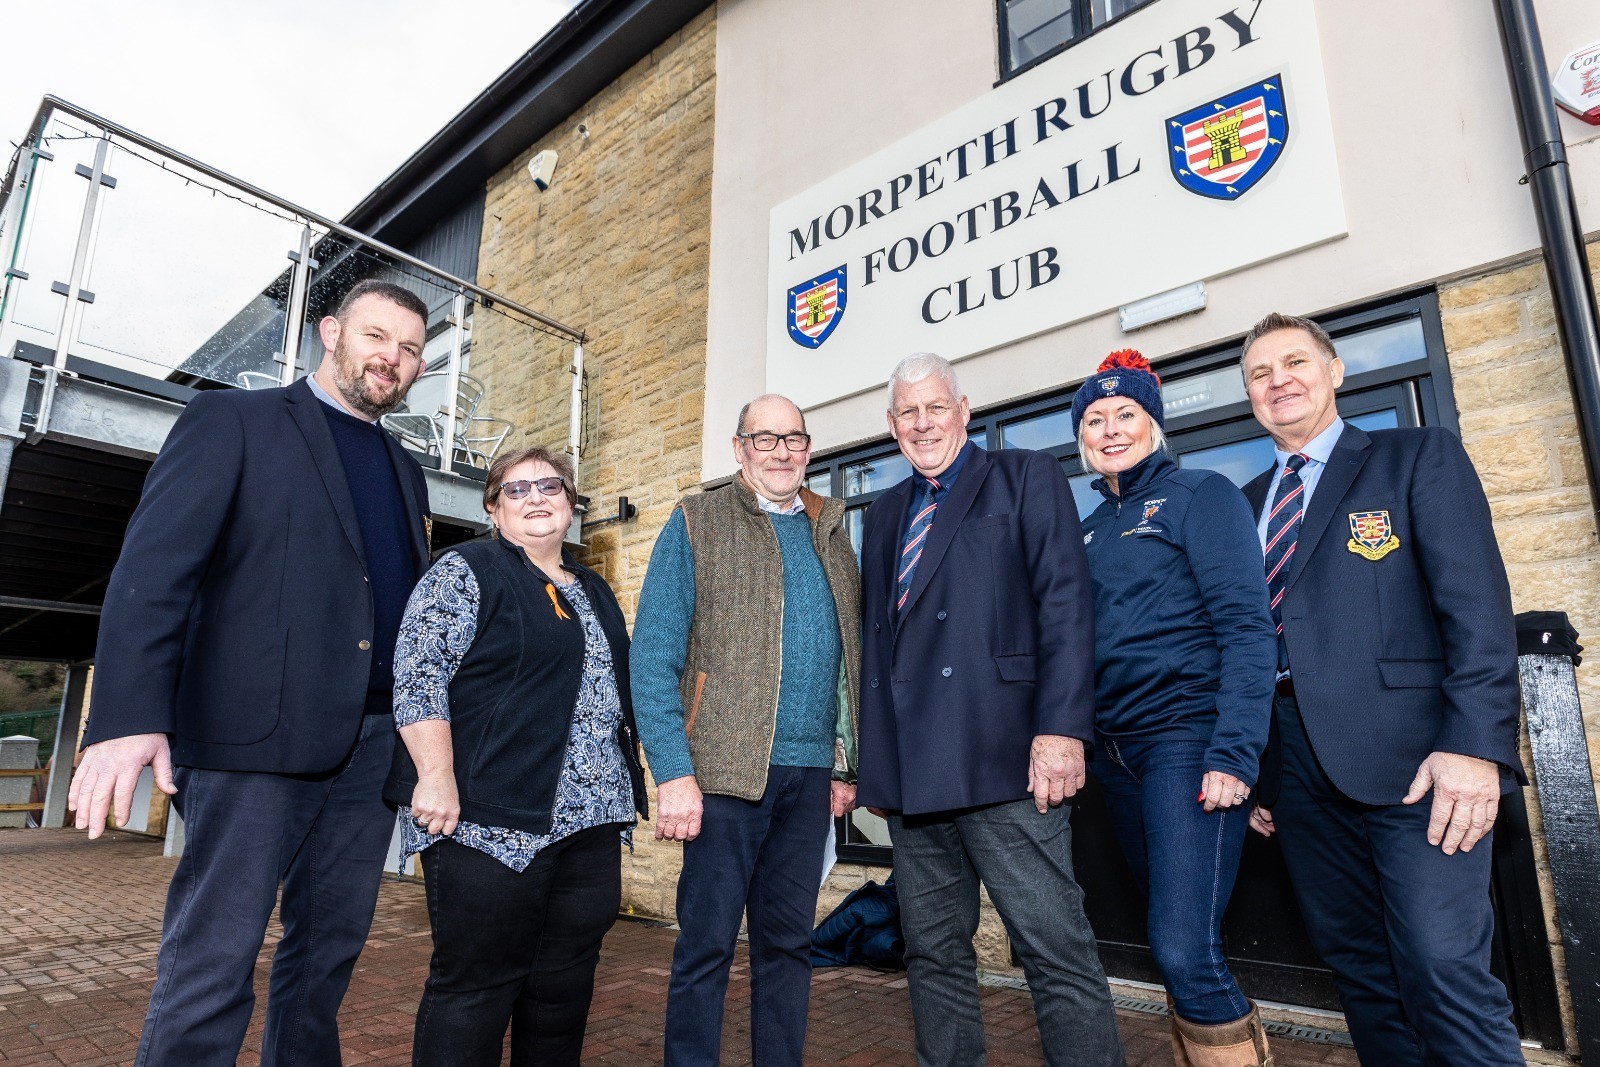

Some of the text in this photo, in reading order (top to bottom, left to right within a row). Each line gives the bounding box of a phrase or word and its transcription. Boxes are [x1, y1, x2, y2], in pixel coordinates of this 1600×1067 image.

[787, 0, 1264, 262] MORPETH RUGBY
[861, 141, 1141, 288] FOOTBALL
[921, 246, 1061, 324] CLUB
